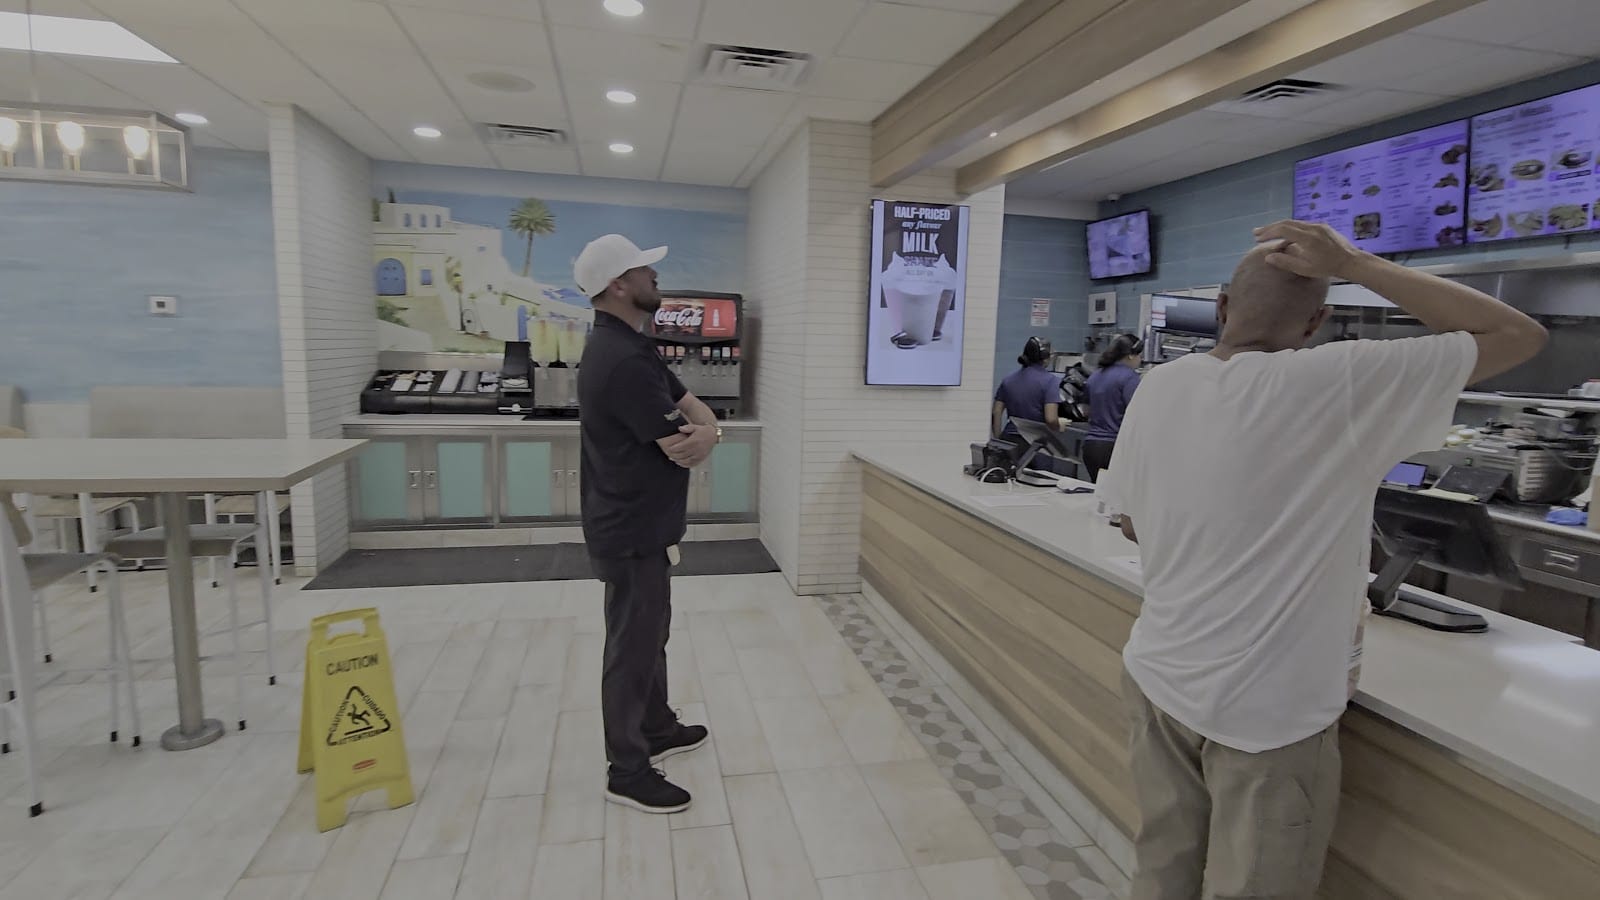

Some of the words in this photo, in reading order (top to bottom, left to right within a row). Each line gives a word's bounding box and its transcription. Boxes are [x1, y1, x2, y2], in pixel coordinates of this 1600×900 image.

[894, 206, 950, 221] HALF-PRICED
[903, 231, 939, 254] MILK
[326, 653, 379, 676] CAUTION
[329, 700, 349, 732] CAUTION
[362, 694, 386, 720] CUIDADO
